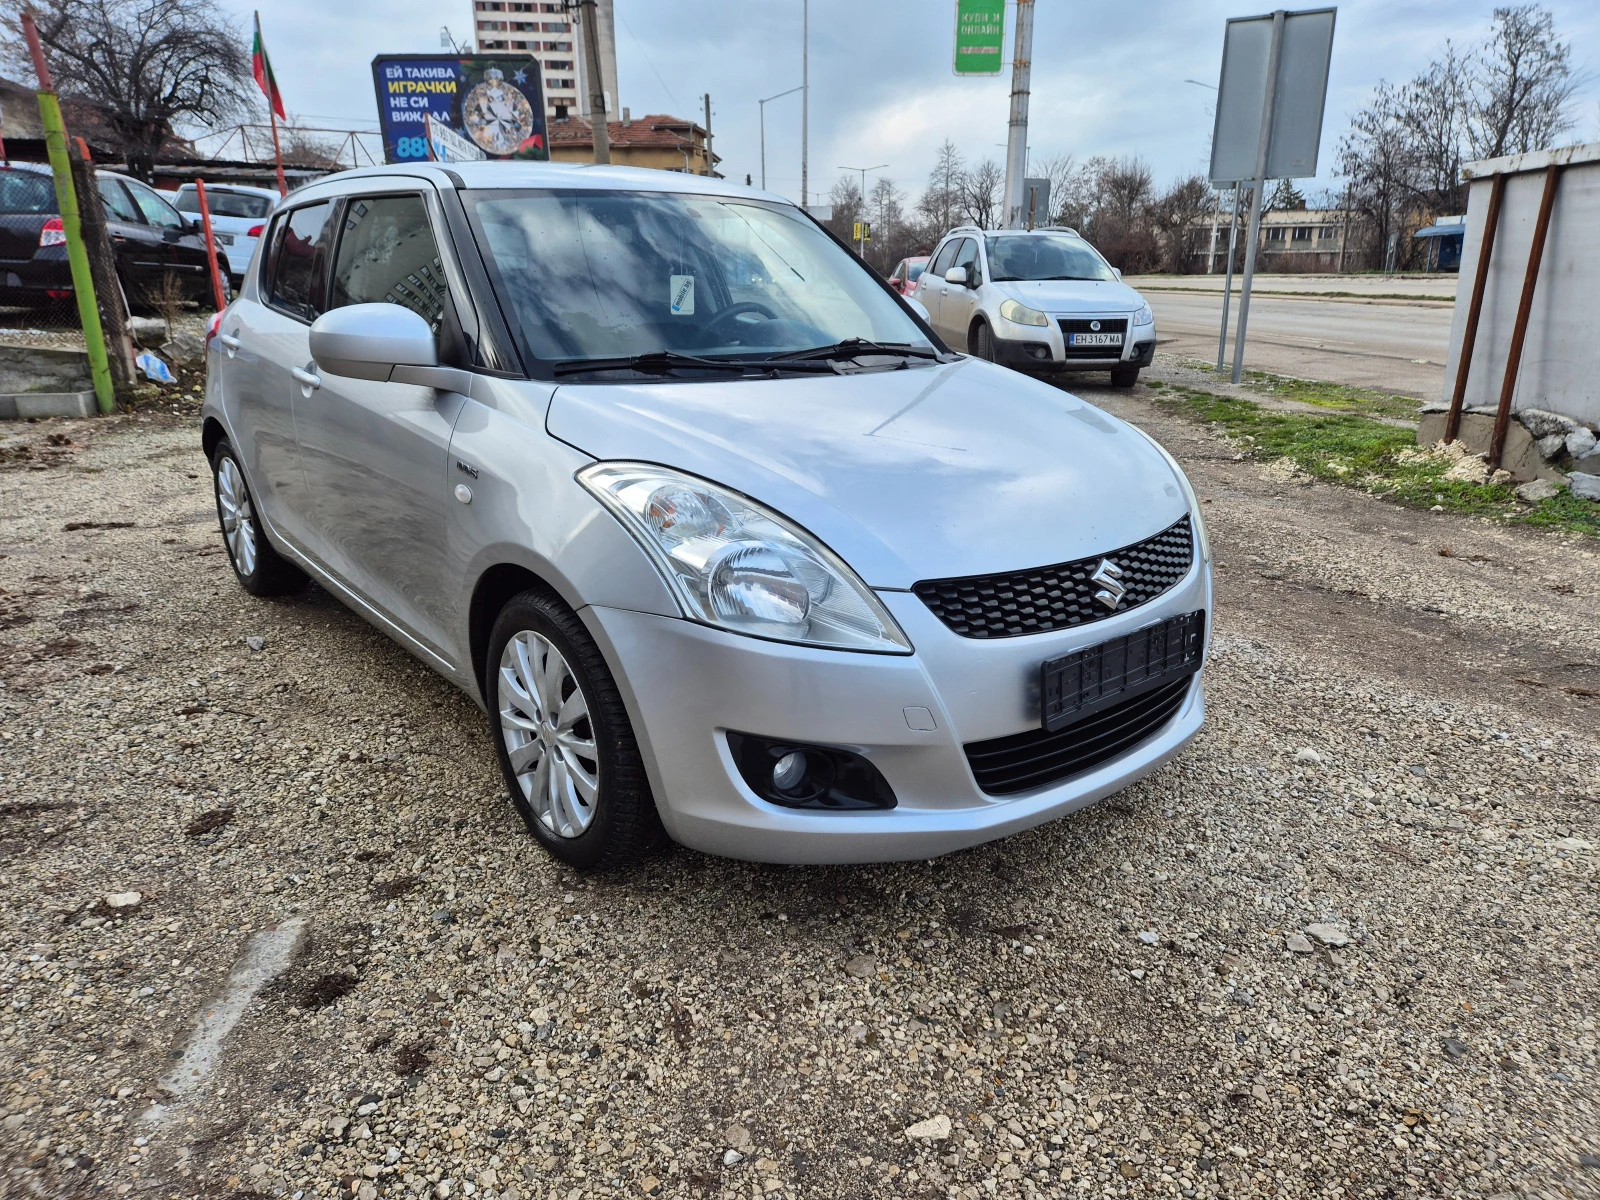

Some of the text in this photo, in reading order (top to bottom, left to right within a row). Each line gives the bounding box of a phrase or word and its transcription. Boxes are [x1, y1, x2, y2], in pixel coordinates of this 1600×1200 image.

[962, 13, 1000, 23] КУПИ И
[961, 24, 1000, 35] ОНЛАЙН
[386, 65, 456, 79] ЕЙ ТАКИВА
[388, 80, 457, 94] ИГРАЧКИ
[390, 96, 429, 108] НЕ СИ
[392, 111, 451, 123] ВИЖАЛ
[1075, 334, 1120, 344] EH 3167 MA
